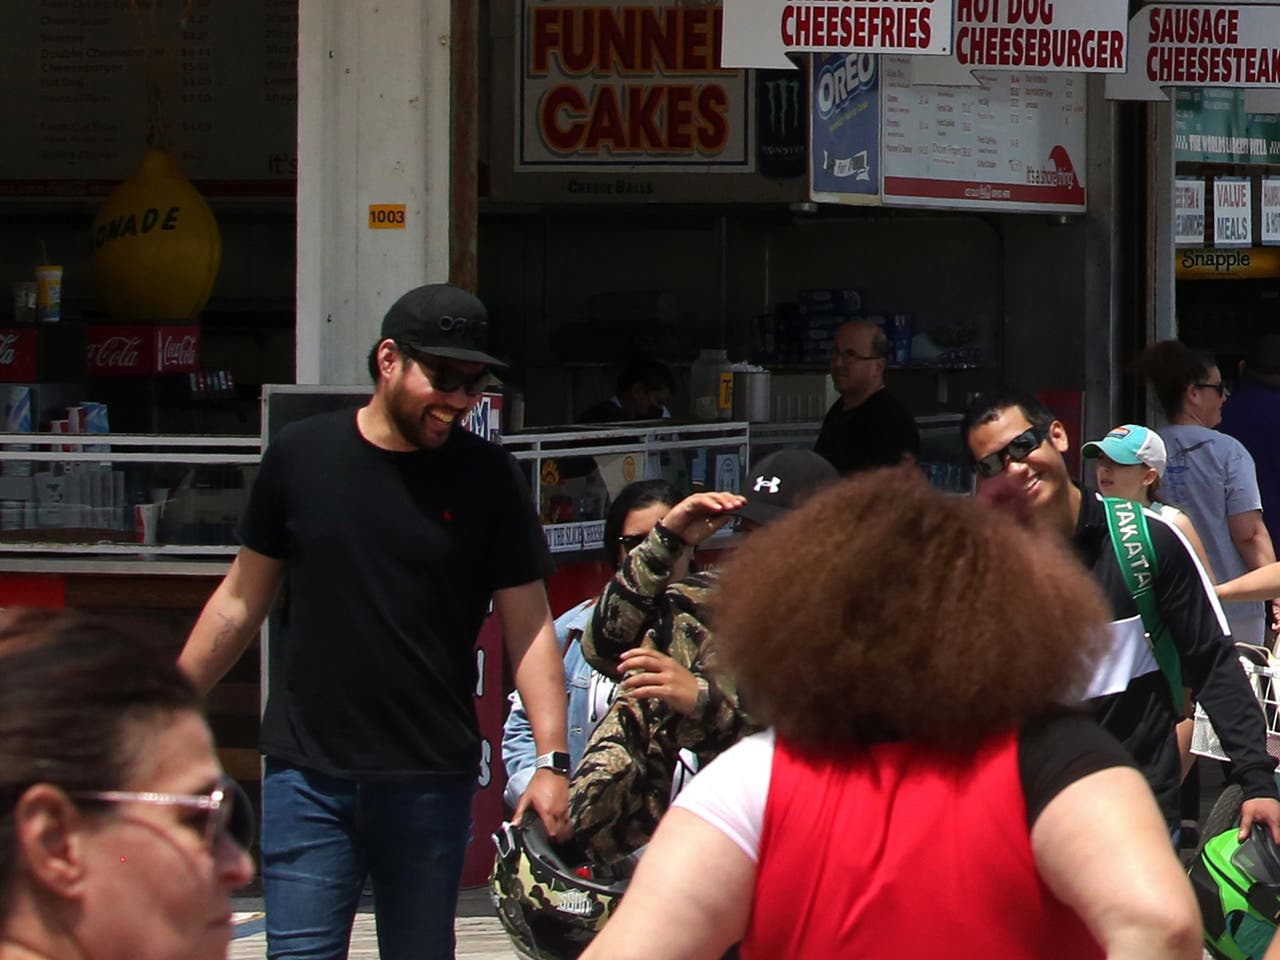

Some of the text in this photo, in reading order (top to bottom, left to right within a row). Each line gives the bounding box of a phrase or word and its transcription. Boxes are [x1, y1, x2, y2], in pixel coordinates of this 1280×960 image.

[781, 5, 931, 49] CHEESEFRIES
[1150, 7, 1239, 43] SAUSAGE
[956, 26, 1124, 69] CHEESEBURGER
[817, 53, 876, 114] OREO
[542, 83, 731, 154] CAKES
[1217, 184, 1247, 207] VALUE
[369, 210, 405, 224] 1003
[1217, 217, 1248, 240] MEALS
[1182, 250, 1250, 272] Snapple
[1113, 500, 1153, 590] TAKATA
